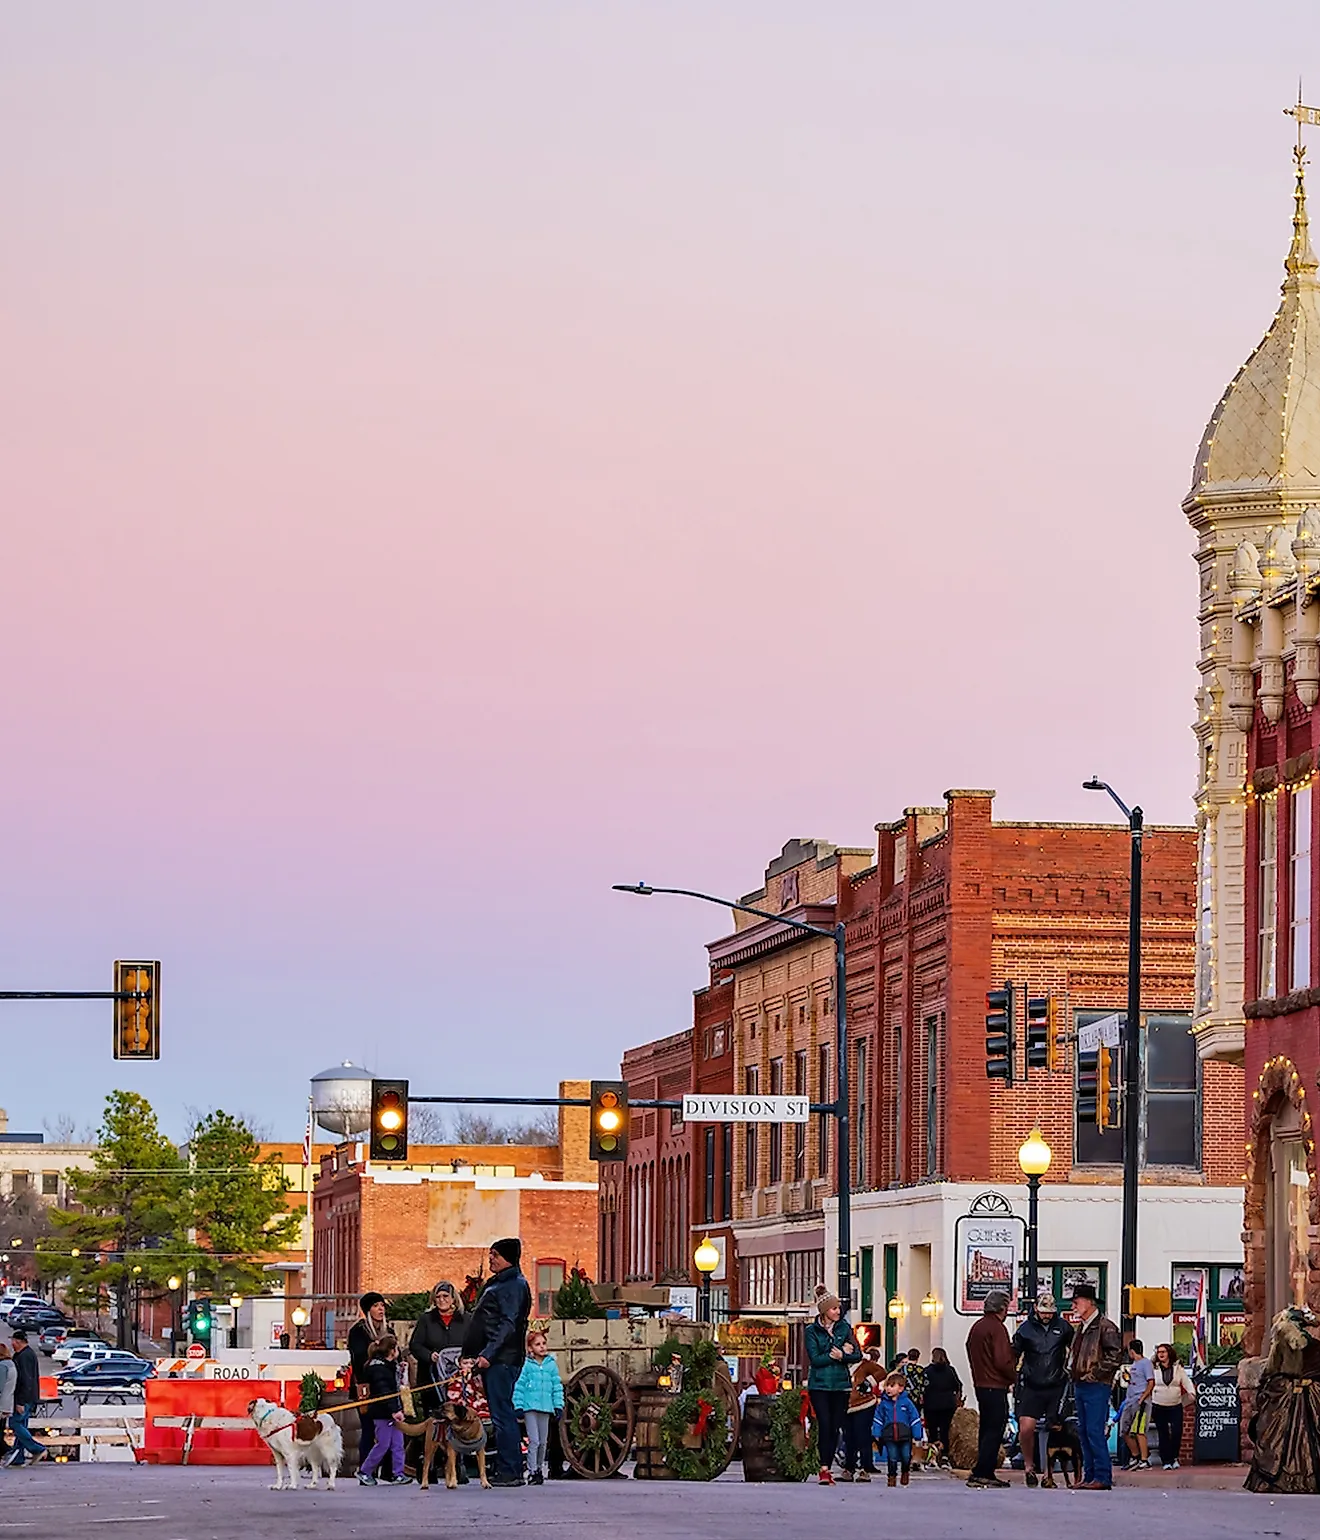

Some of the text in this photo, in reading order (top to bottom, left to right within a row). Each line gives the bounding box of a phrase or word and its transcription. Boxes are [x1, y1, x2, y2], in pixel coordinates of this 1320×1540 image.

[686, 1100, 808, 1116] DIVISION ST
[188, 1349, 205, 1357] STOP
[213, 1367, 250, 1380] ROAD
[1197, 1383, 1239, 1395] COUNTRY
[1198, 1395, 1237, 1407] CORNER
